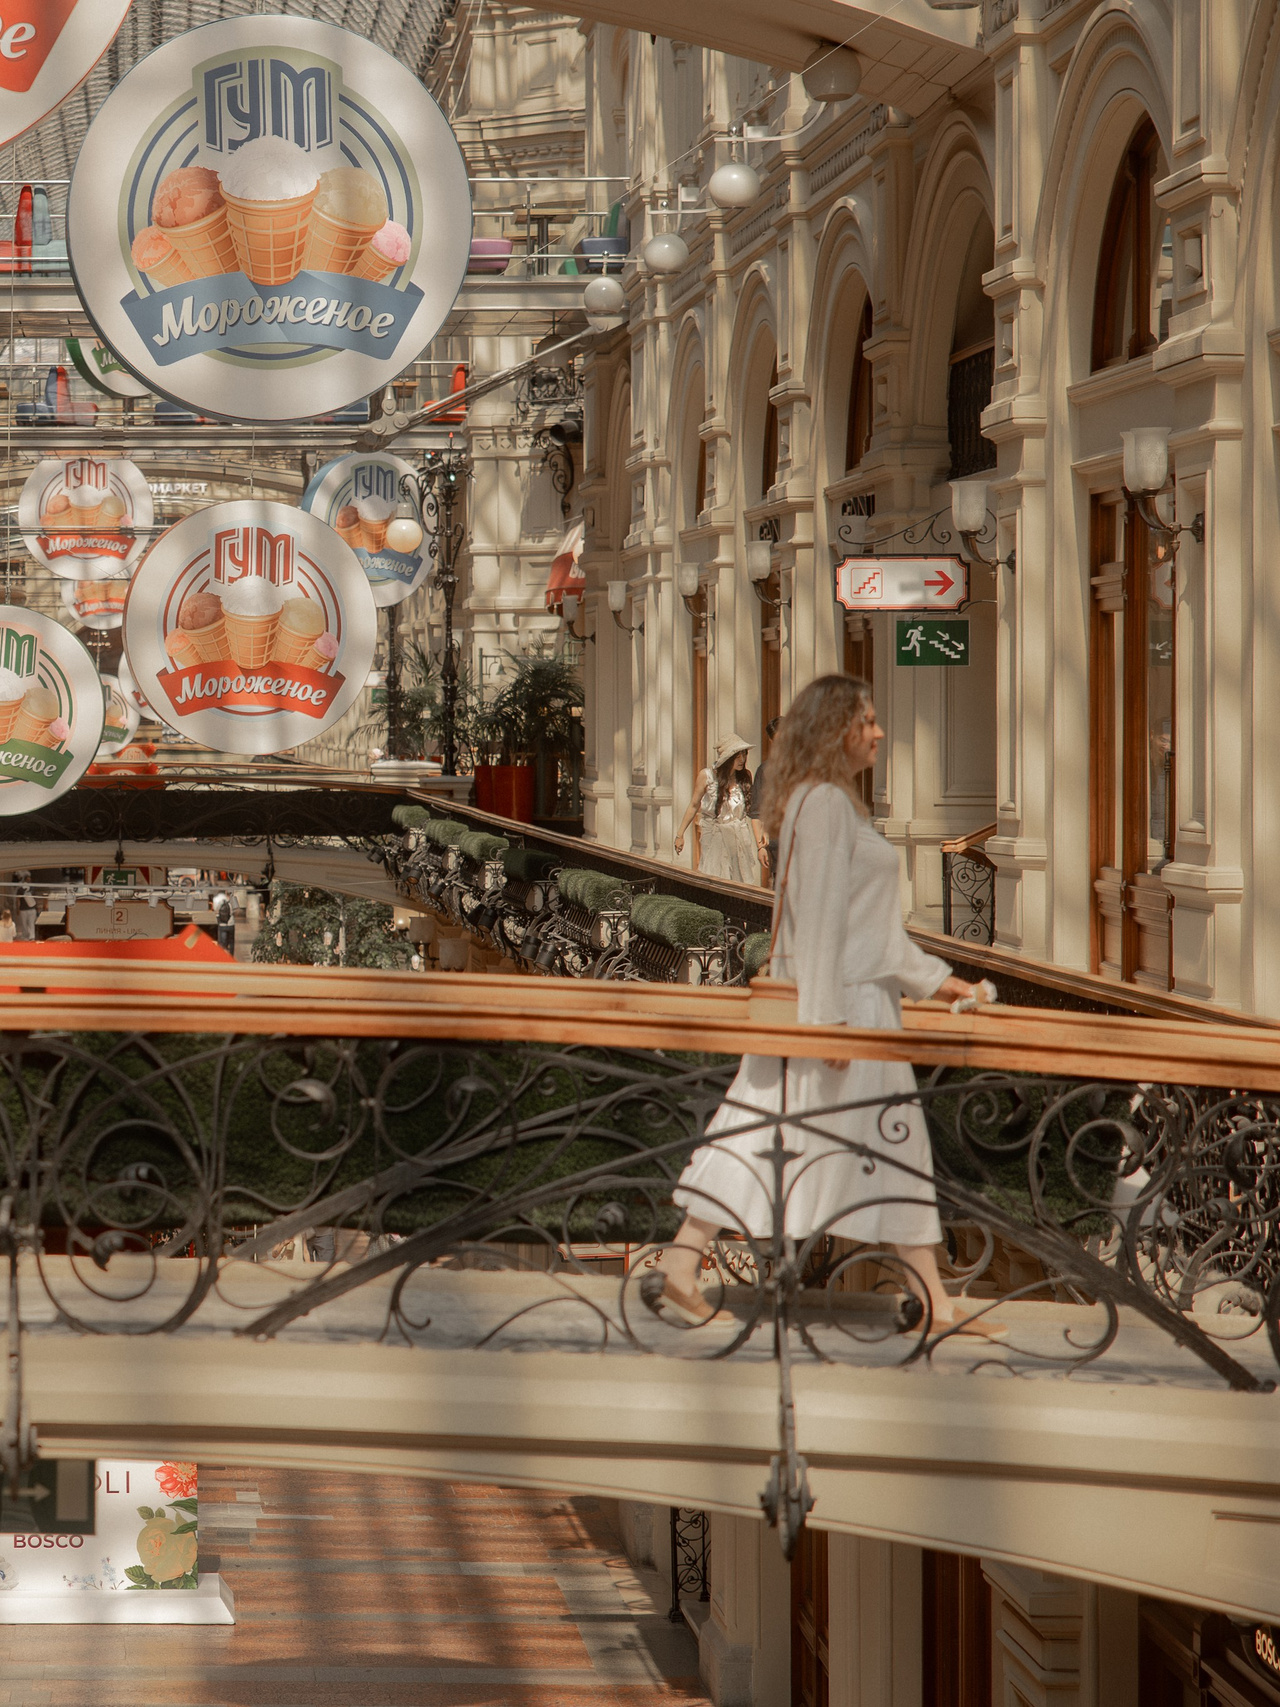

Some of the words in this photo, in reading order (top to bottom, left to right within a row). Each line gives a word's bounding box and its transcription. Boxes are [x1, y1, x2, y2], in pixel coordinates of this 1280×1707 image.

[204, 59, 335, 151] ГУМ
[152, 293, 396, 347] Мороженое
[65, 460, 110, 491] ГУМ
[354, 465, 396, 503] ГУМ
[46, 537, 128, 554] Мороженое
[214, 527, 295, 586] ГУМ
[175, 672, 326, 705] Мороженое
[96, 927, 122, 935] ЛИНИЯ
[115, 911, 123, 922] 2
[13, 1533, 84, 1549] BOSCO
[1255, 1629, 1280, 1670] BOSC
